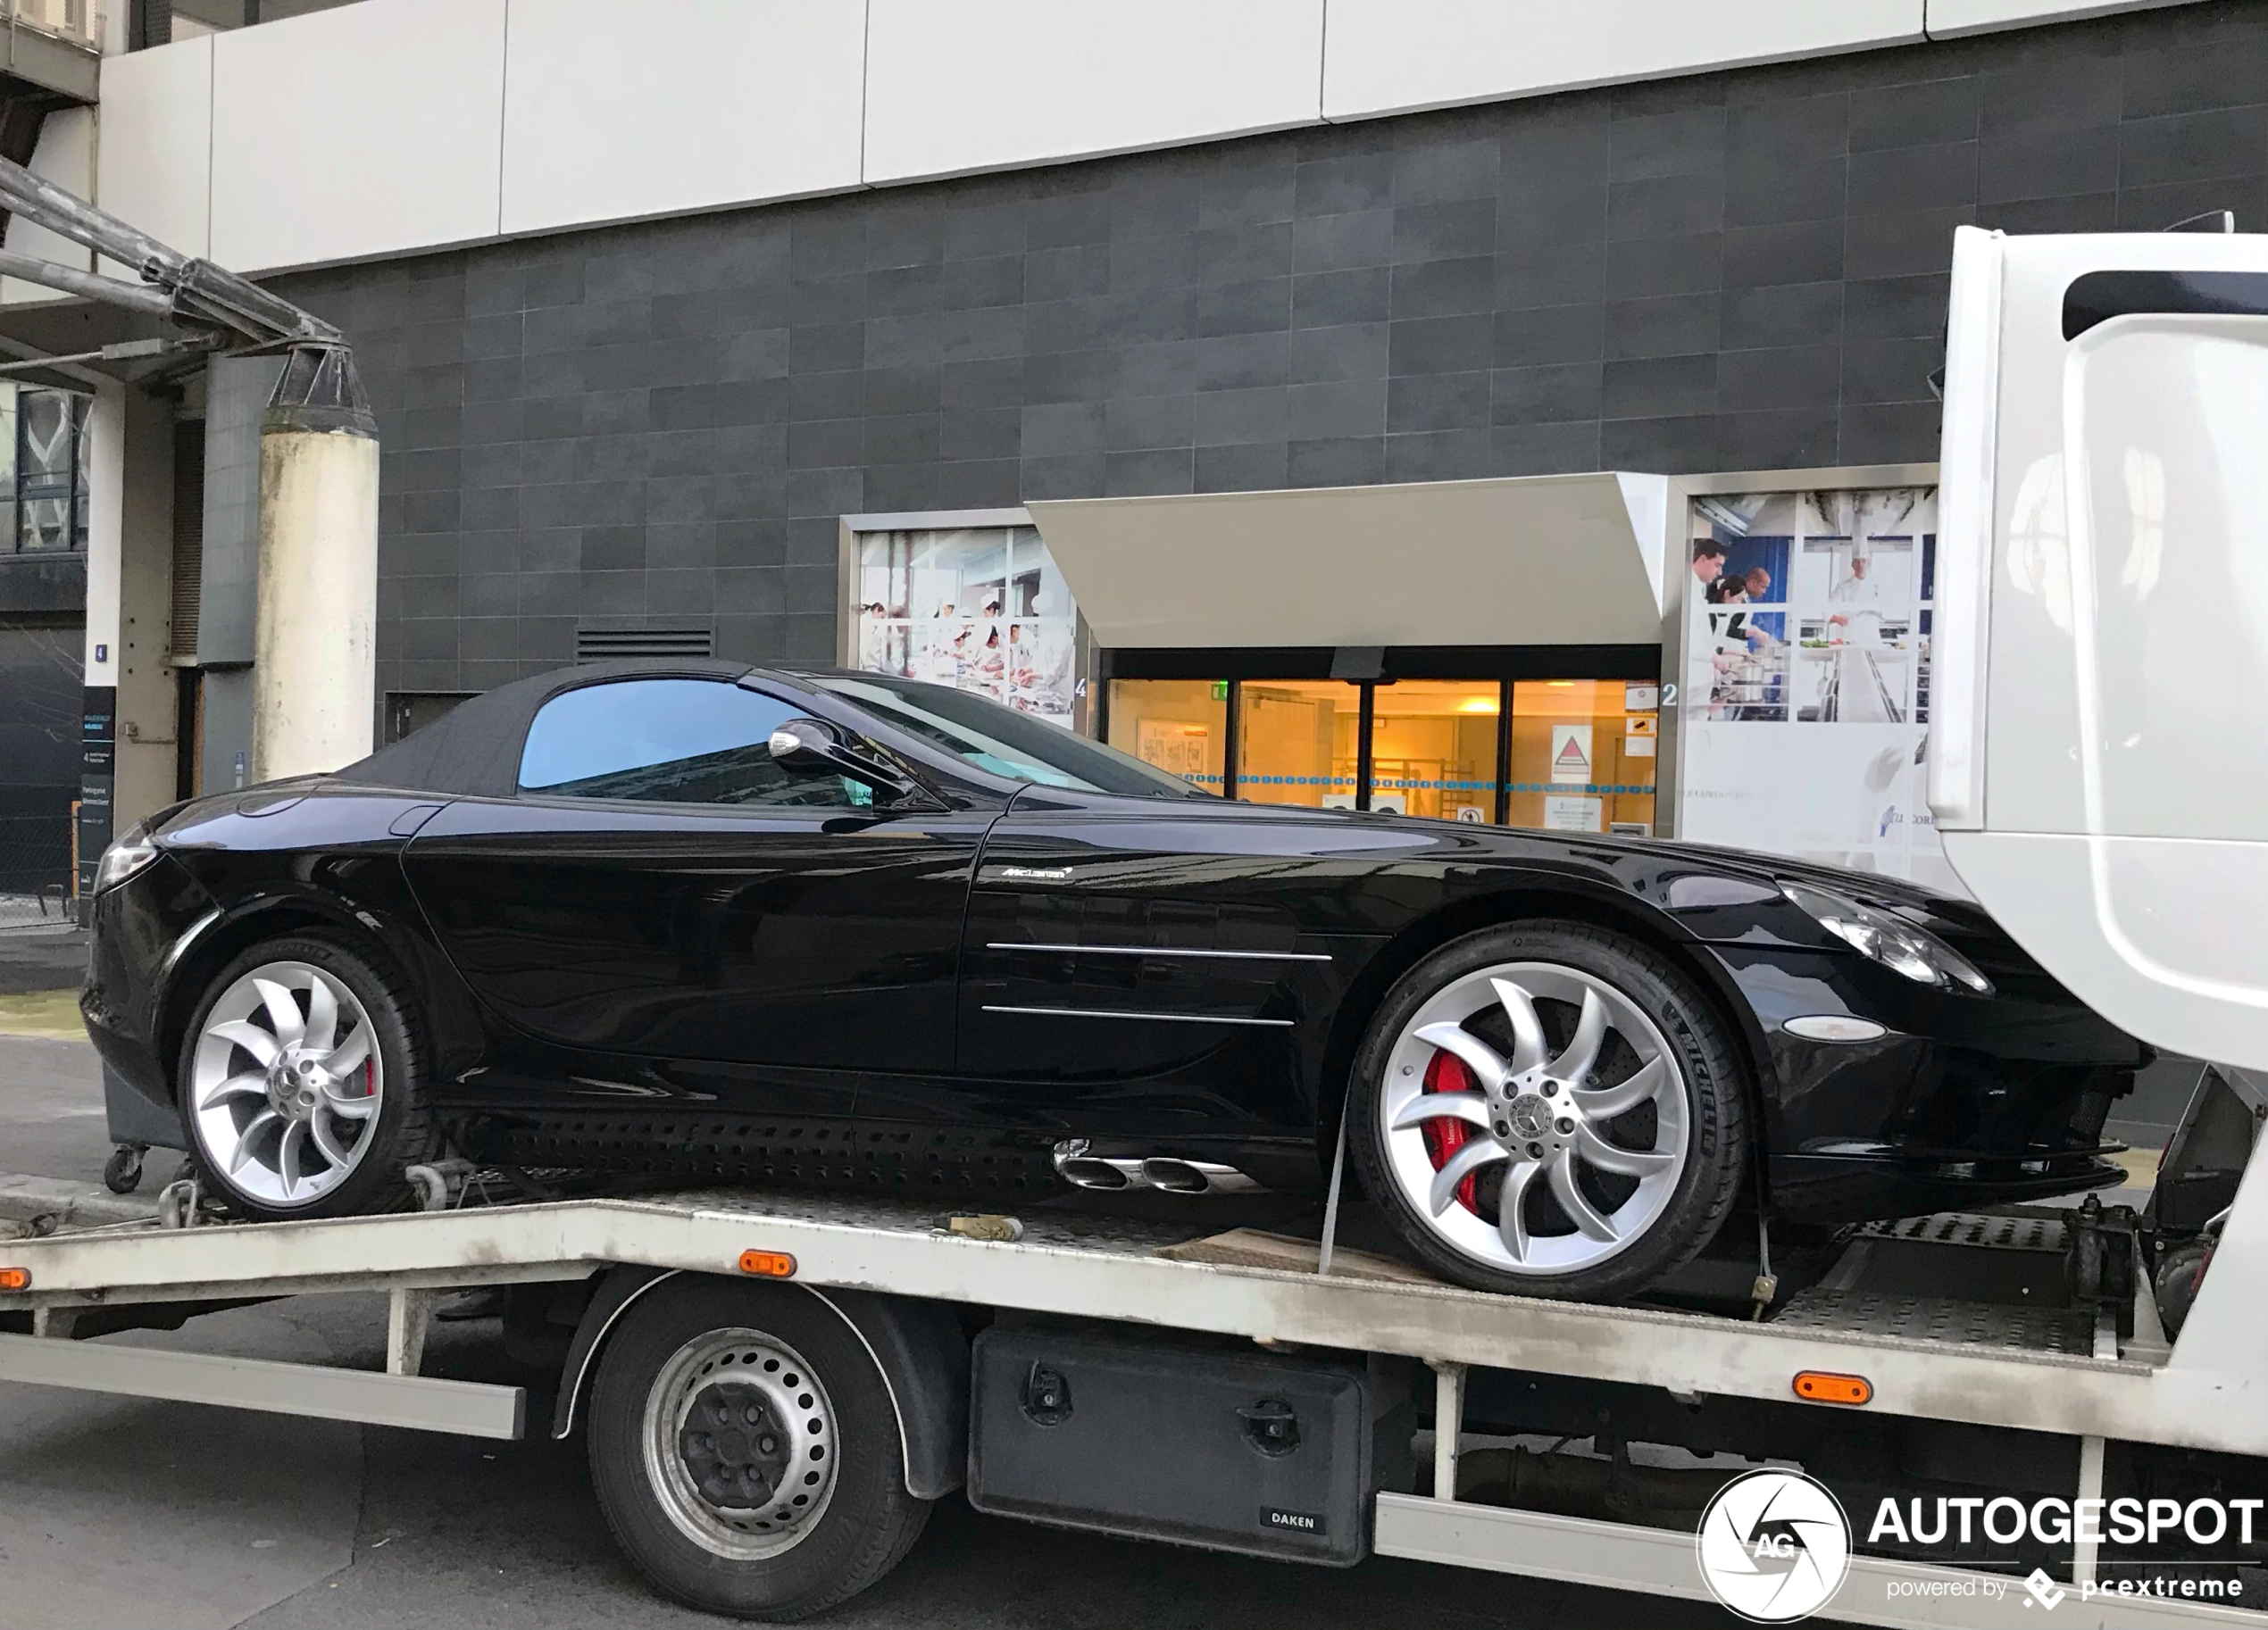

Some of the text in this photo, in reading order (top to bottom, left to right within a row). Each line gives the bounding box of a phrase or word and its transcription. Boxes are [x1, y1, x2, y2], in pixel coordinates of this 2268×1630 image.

[1075, 678, 1087, 697] 4
[1662, 683, 1678, 706] 2
[1001, 868, 1065, 878] McLaren
[1680, 1032, 1717, 1150] MICHELIN
[1271, 1512, 1315, 1529] DAKEN
